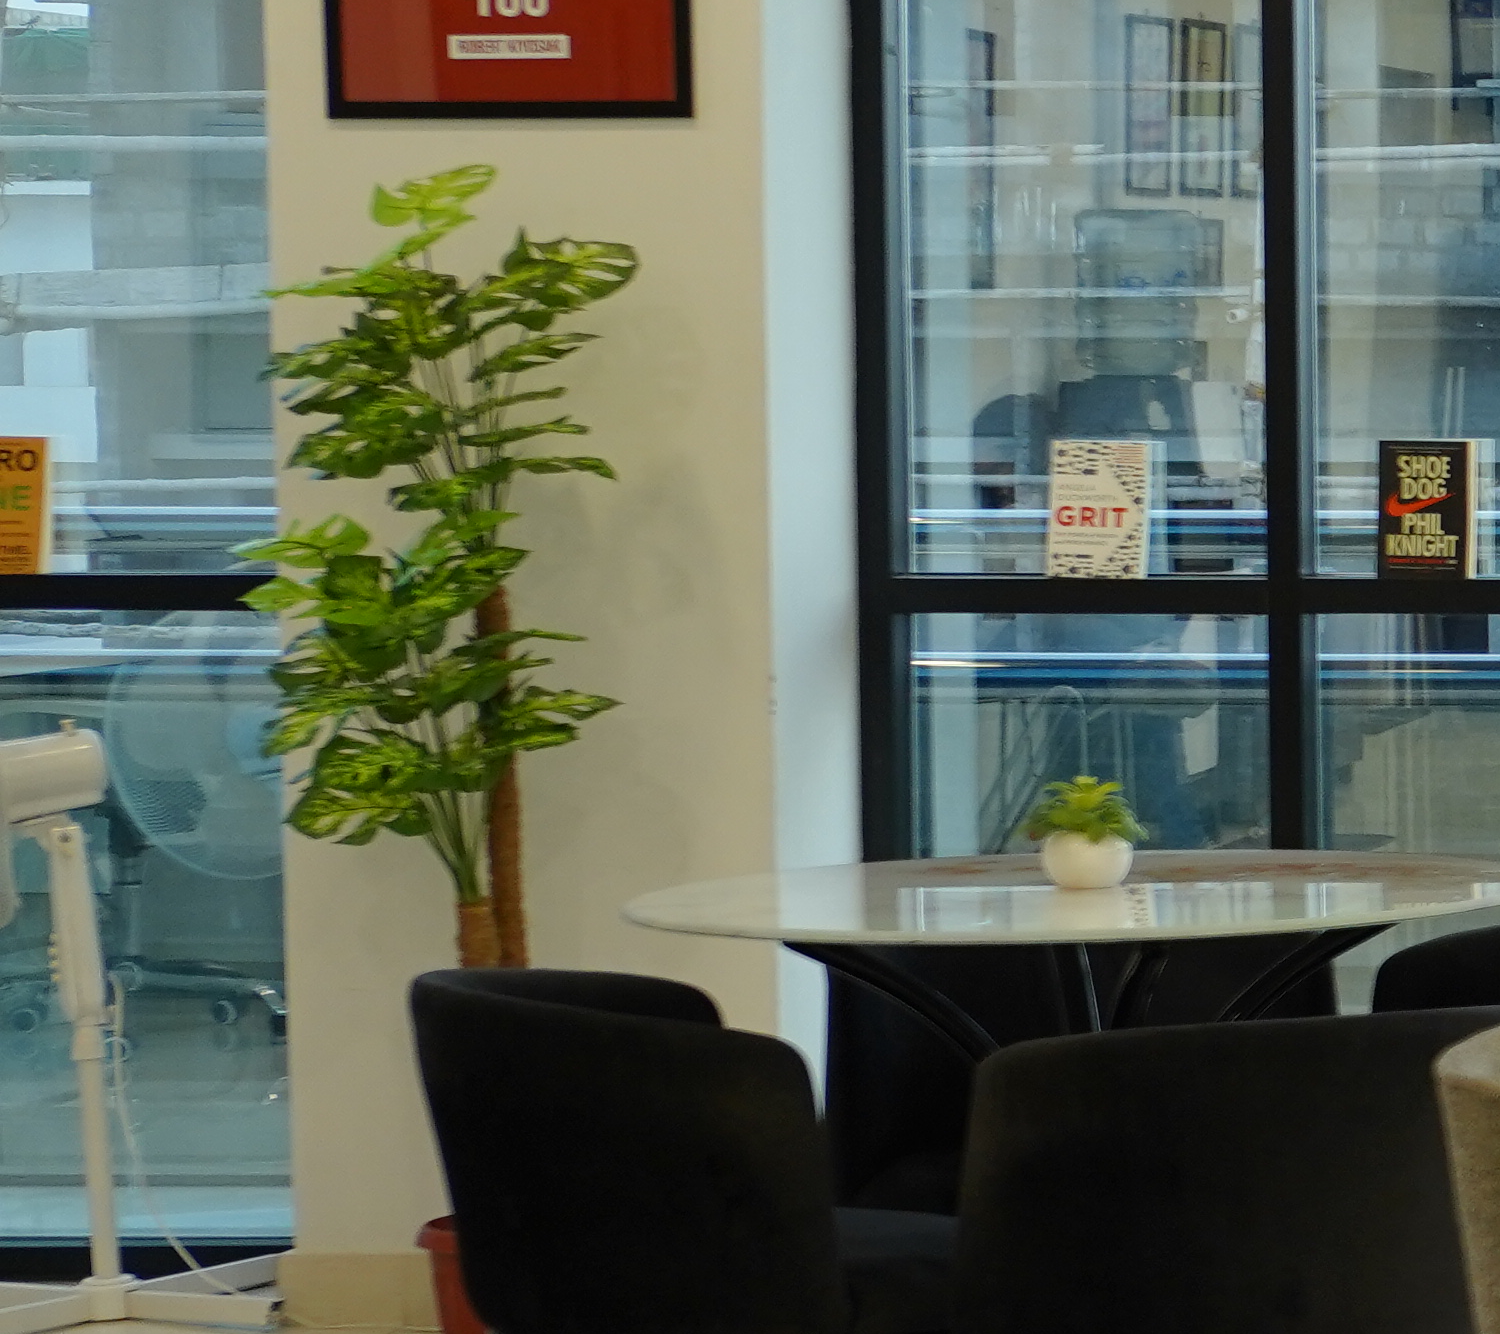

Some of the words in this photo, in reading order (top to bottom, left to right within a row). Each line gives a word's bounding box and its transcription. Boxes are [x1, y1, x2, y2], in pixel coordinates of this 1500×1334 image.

[1397, 455, 1451, 479] SHOE
[1400, 478, 1447, 500] DOG
[1055, 505, 1129, 528] GRIT
[1401, 513, 1445, 535] PHIL
[1385, 534, 1459, 558] KNIGHT
